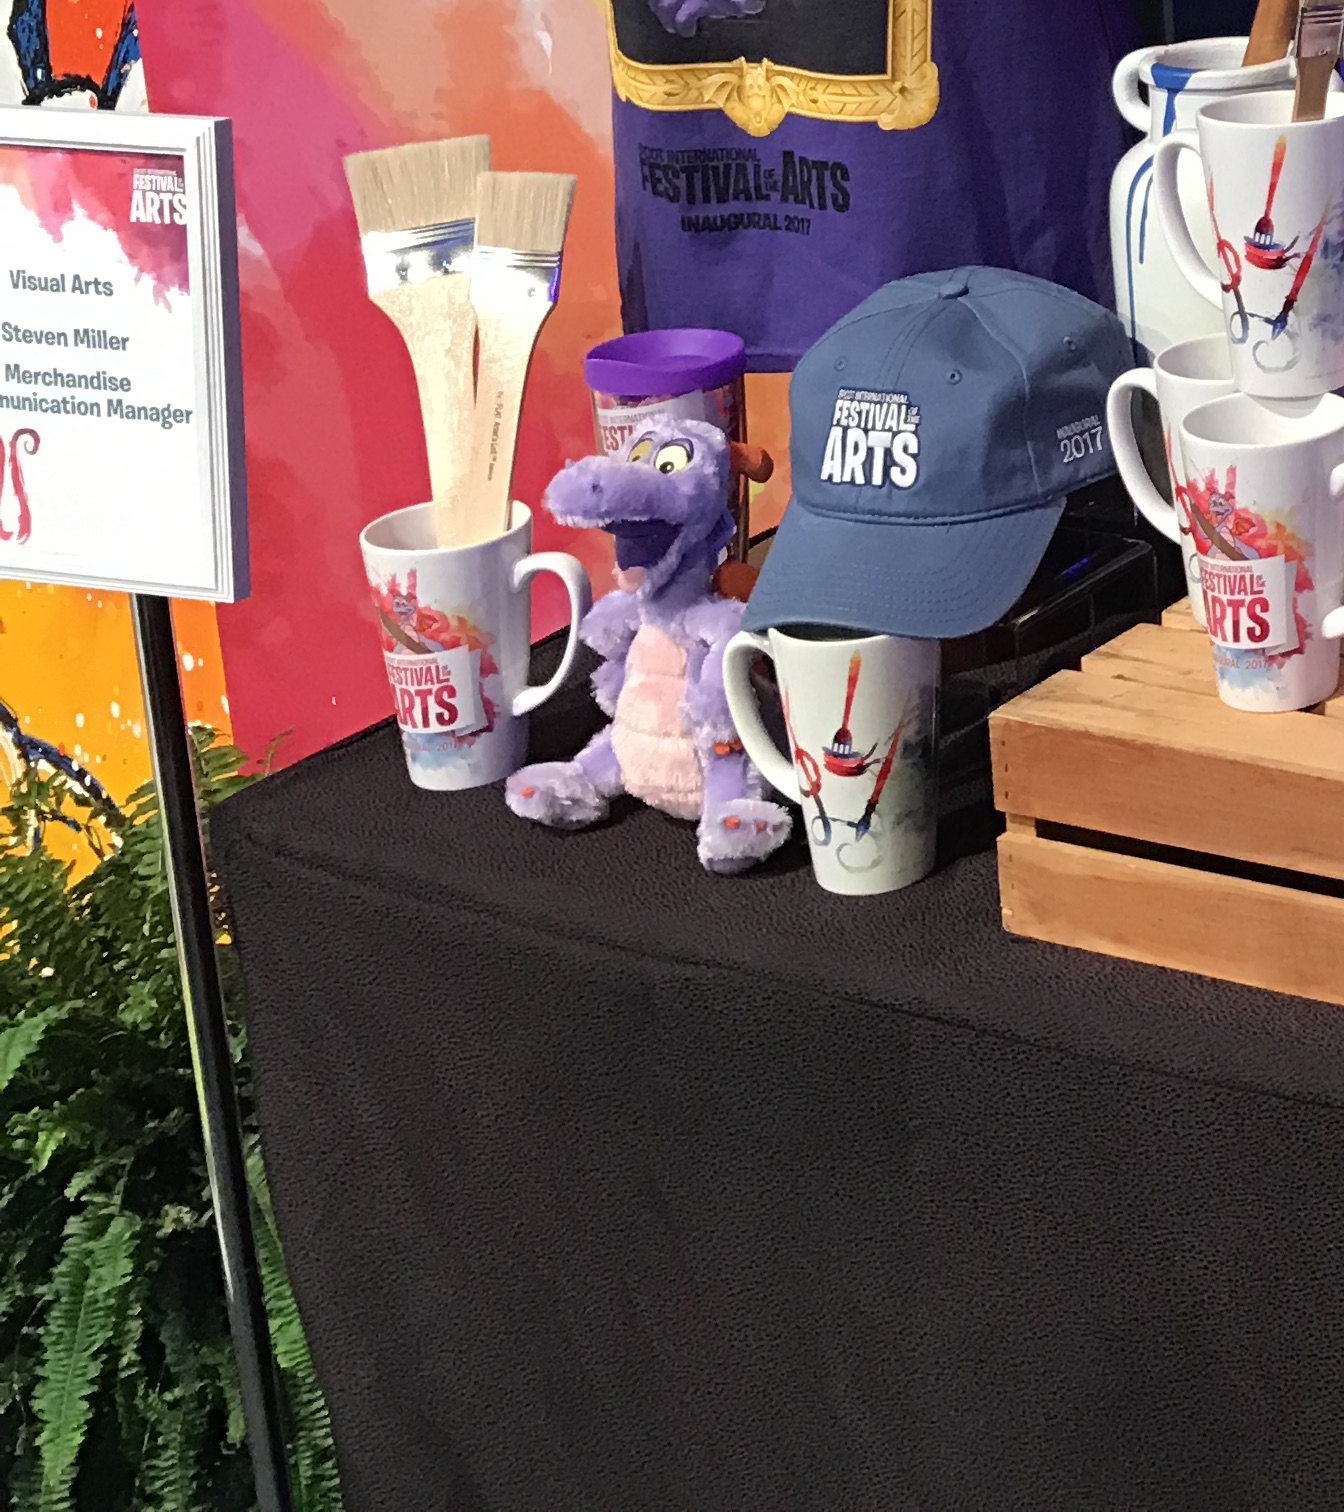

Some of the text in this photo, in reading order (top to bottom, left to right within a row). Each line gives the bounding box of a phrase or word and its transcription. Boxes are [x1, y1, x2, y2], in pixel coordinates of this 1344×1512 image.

[667, 147, 760, 164] INTERNATIONAL
[133, 174, 183, 192] FESTIVAL
[641, 161, 771, 205] FESTIVAL
[763, 168, 776, 179] OF
[780, 150, 850, 213] ARTS
[130, 190, 187, 225] ARTS
[681, 213, 811, 235] INAUGURAL 2017
[9, 269, 114, 297] Visual Arts
[1, 322, 129, 351] Steven Miller
[5, 364, 131, 392] Merchandise
[107, 399, 193, 429] Manager
[833, 399, 915, 431] FESTIVAL
[821, 426, 918, 487] ARTS
[1060, 426, 1102, 463] 2017
